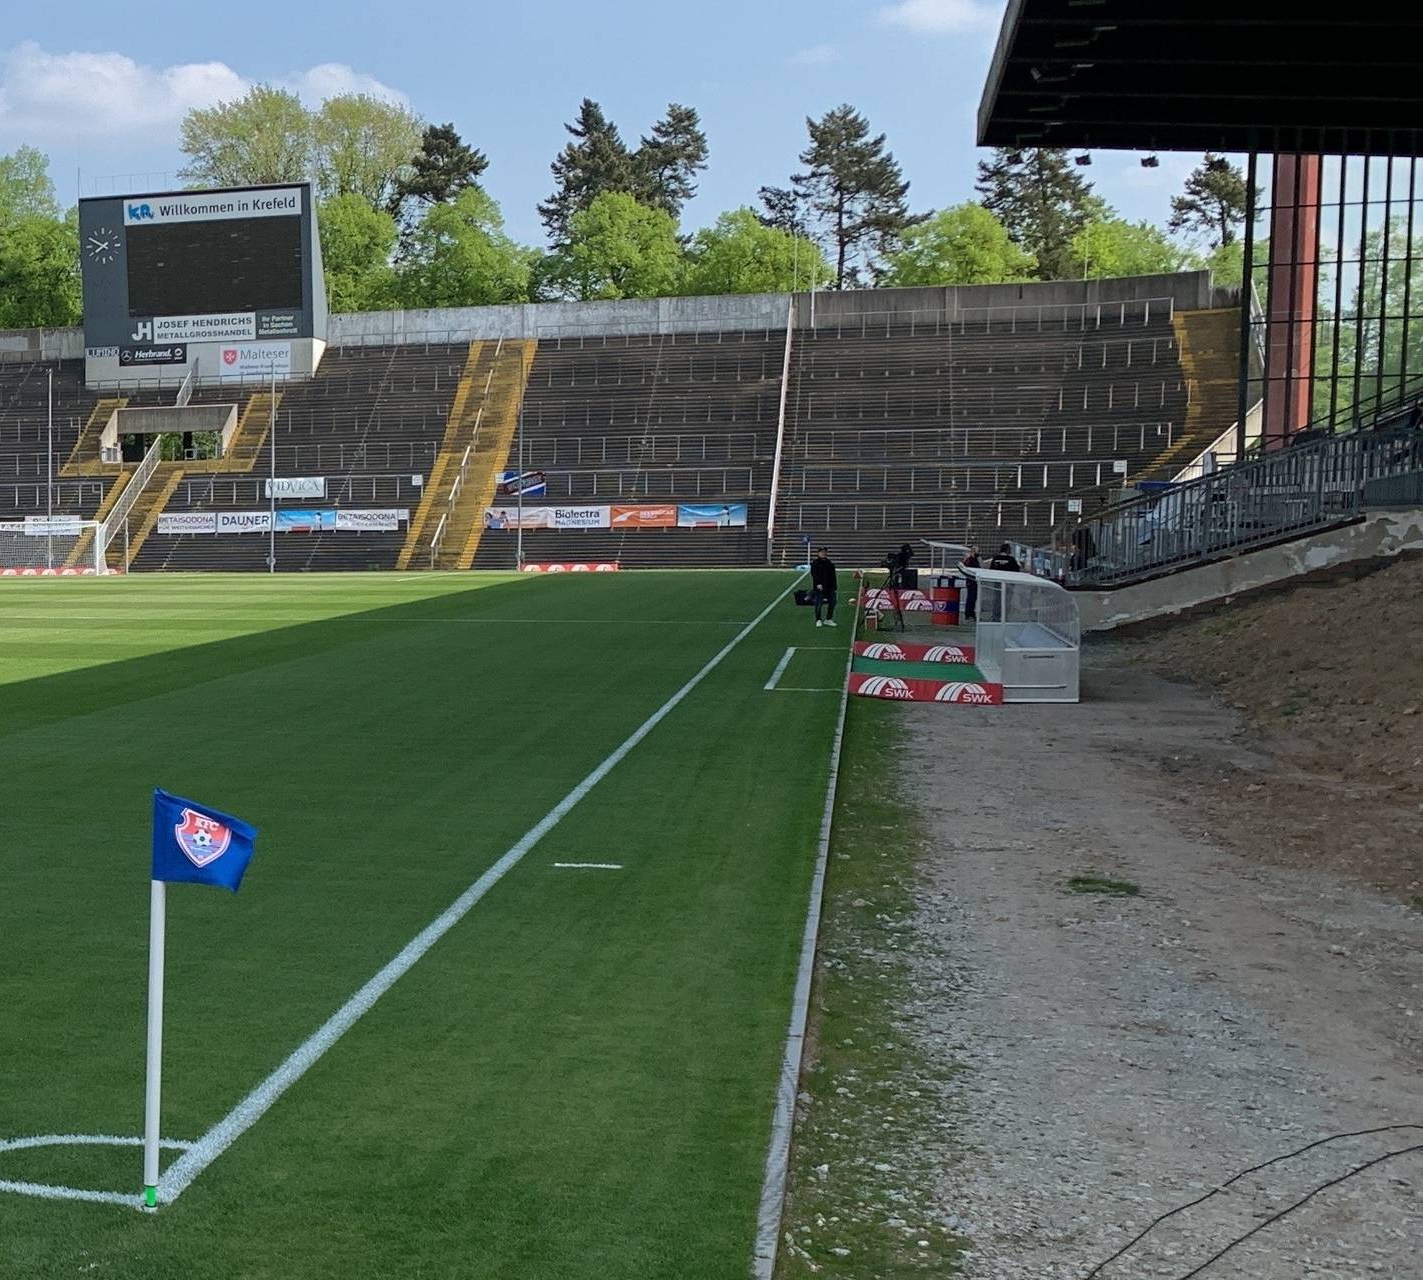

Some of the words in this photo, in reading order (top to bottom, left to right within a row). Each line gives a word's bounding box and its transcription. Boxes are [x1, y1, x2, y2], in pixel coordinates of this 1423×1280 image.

[159, 200, 234, 217] Willkommen
[237, 200, 249, 211] in
[252, 197, 296, 210] Krefeld
[157, 320, 188, 329] JOSEF
[192, 316, 253, 327] HENDRICHS
[157, 328, 253, 340] METALLGROSSHANDEL
[240, 349, 289, 360] Malteser
[555, 509, 600, 519] Biolectra
[222, 516, 269, 526] DAUNER
[945, 655, 968, 663] SWK
[885, 688, 914, 699] SWK
[963, 693, 992, 703] SWK
